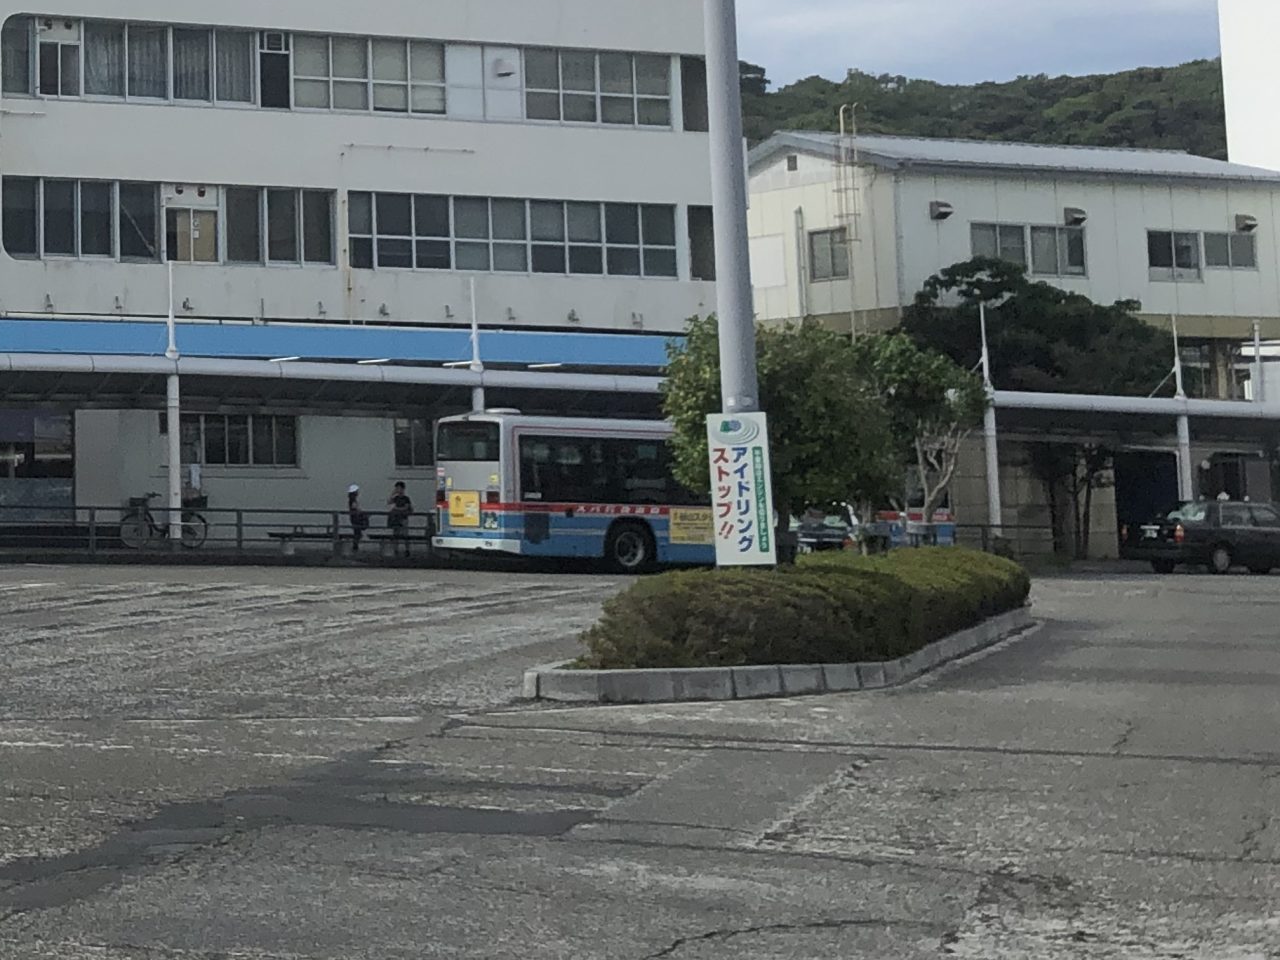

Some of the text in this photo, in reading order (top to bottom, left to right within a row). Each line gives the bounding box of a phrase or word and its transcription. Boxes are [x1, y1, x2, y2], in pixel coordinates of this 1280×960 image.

[731, 446, 754, 552] アイドリング
